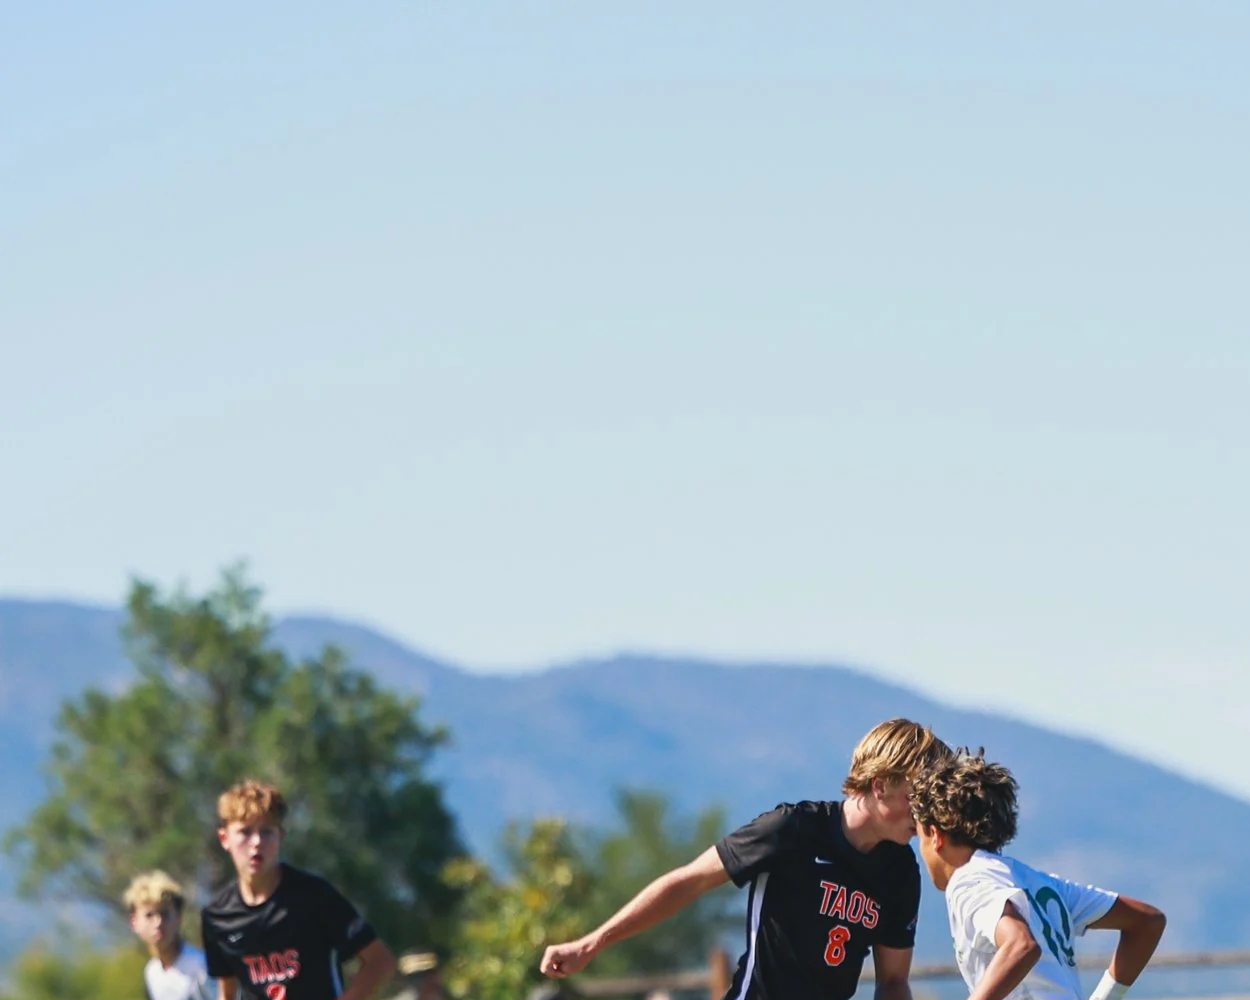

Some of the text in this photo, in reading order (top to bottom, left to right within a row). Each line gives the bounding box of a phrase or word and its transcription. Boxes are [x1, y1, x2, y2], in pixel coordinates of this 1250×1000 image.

[819, 880, 881, 930] TAOS
[242, 948, 302, 985] TAOS
[823, 924, 851, 967] 8
